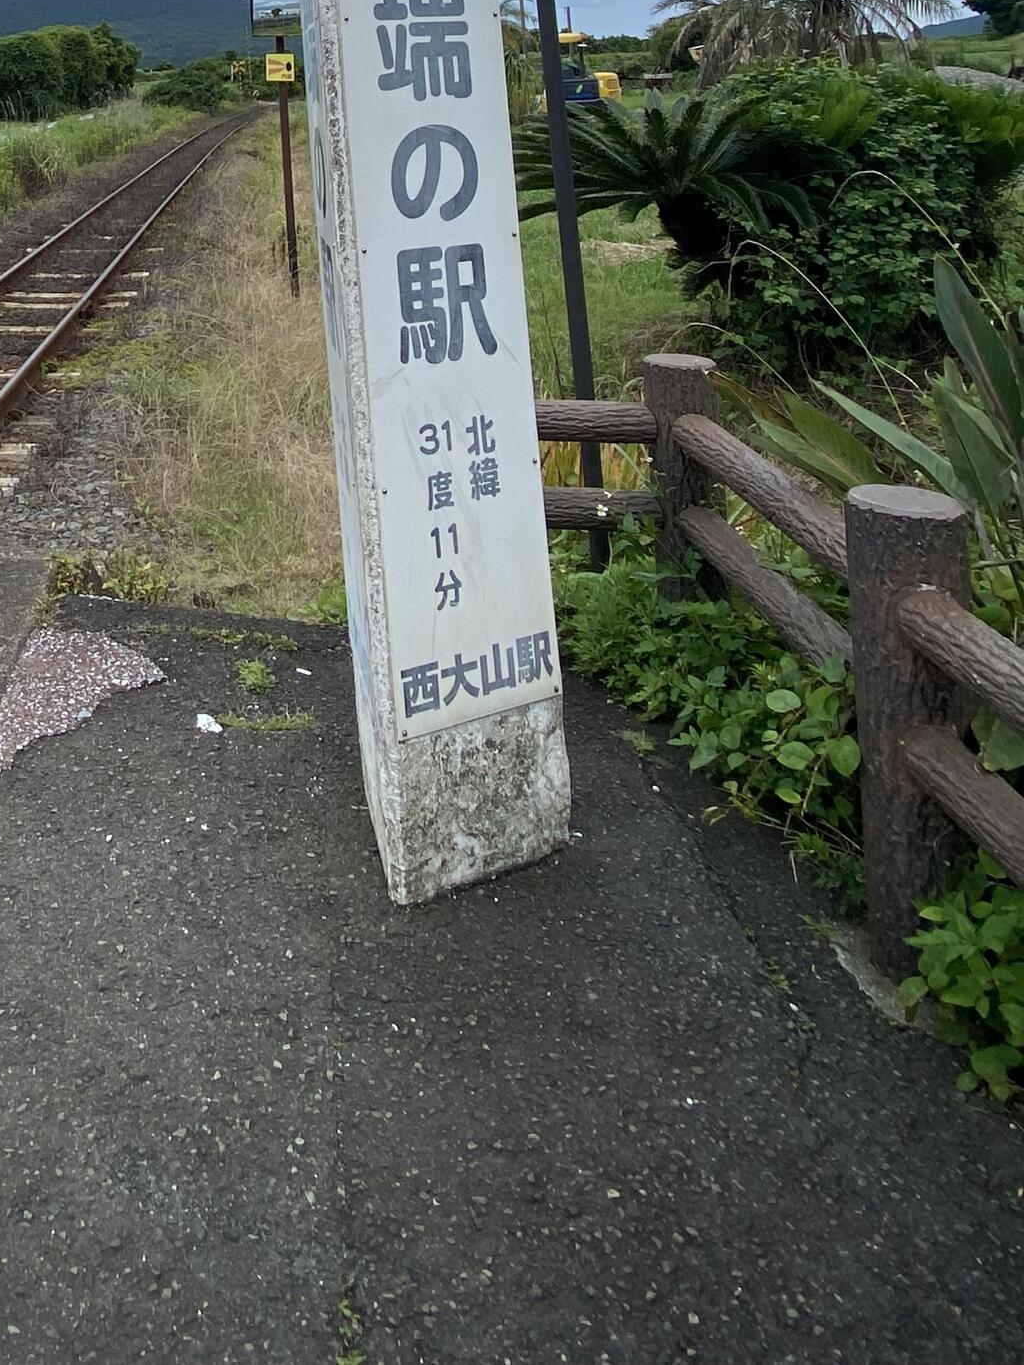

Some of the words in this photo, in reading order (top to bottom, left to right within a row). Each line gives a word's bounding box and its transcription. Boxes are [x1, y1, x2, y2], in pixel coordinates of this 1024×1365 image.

[466, 415, 500, 501] 北緯
[400, 631, 552, 717] 西大山駅
